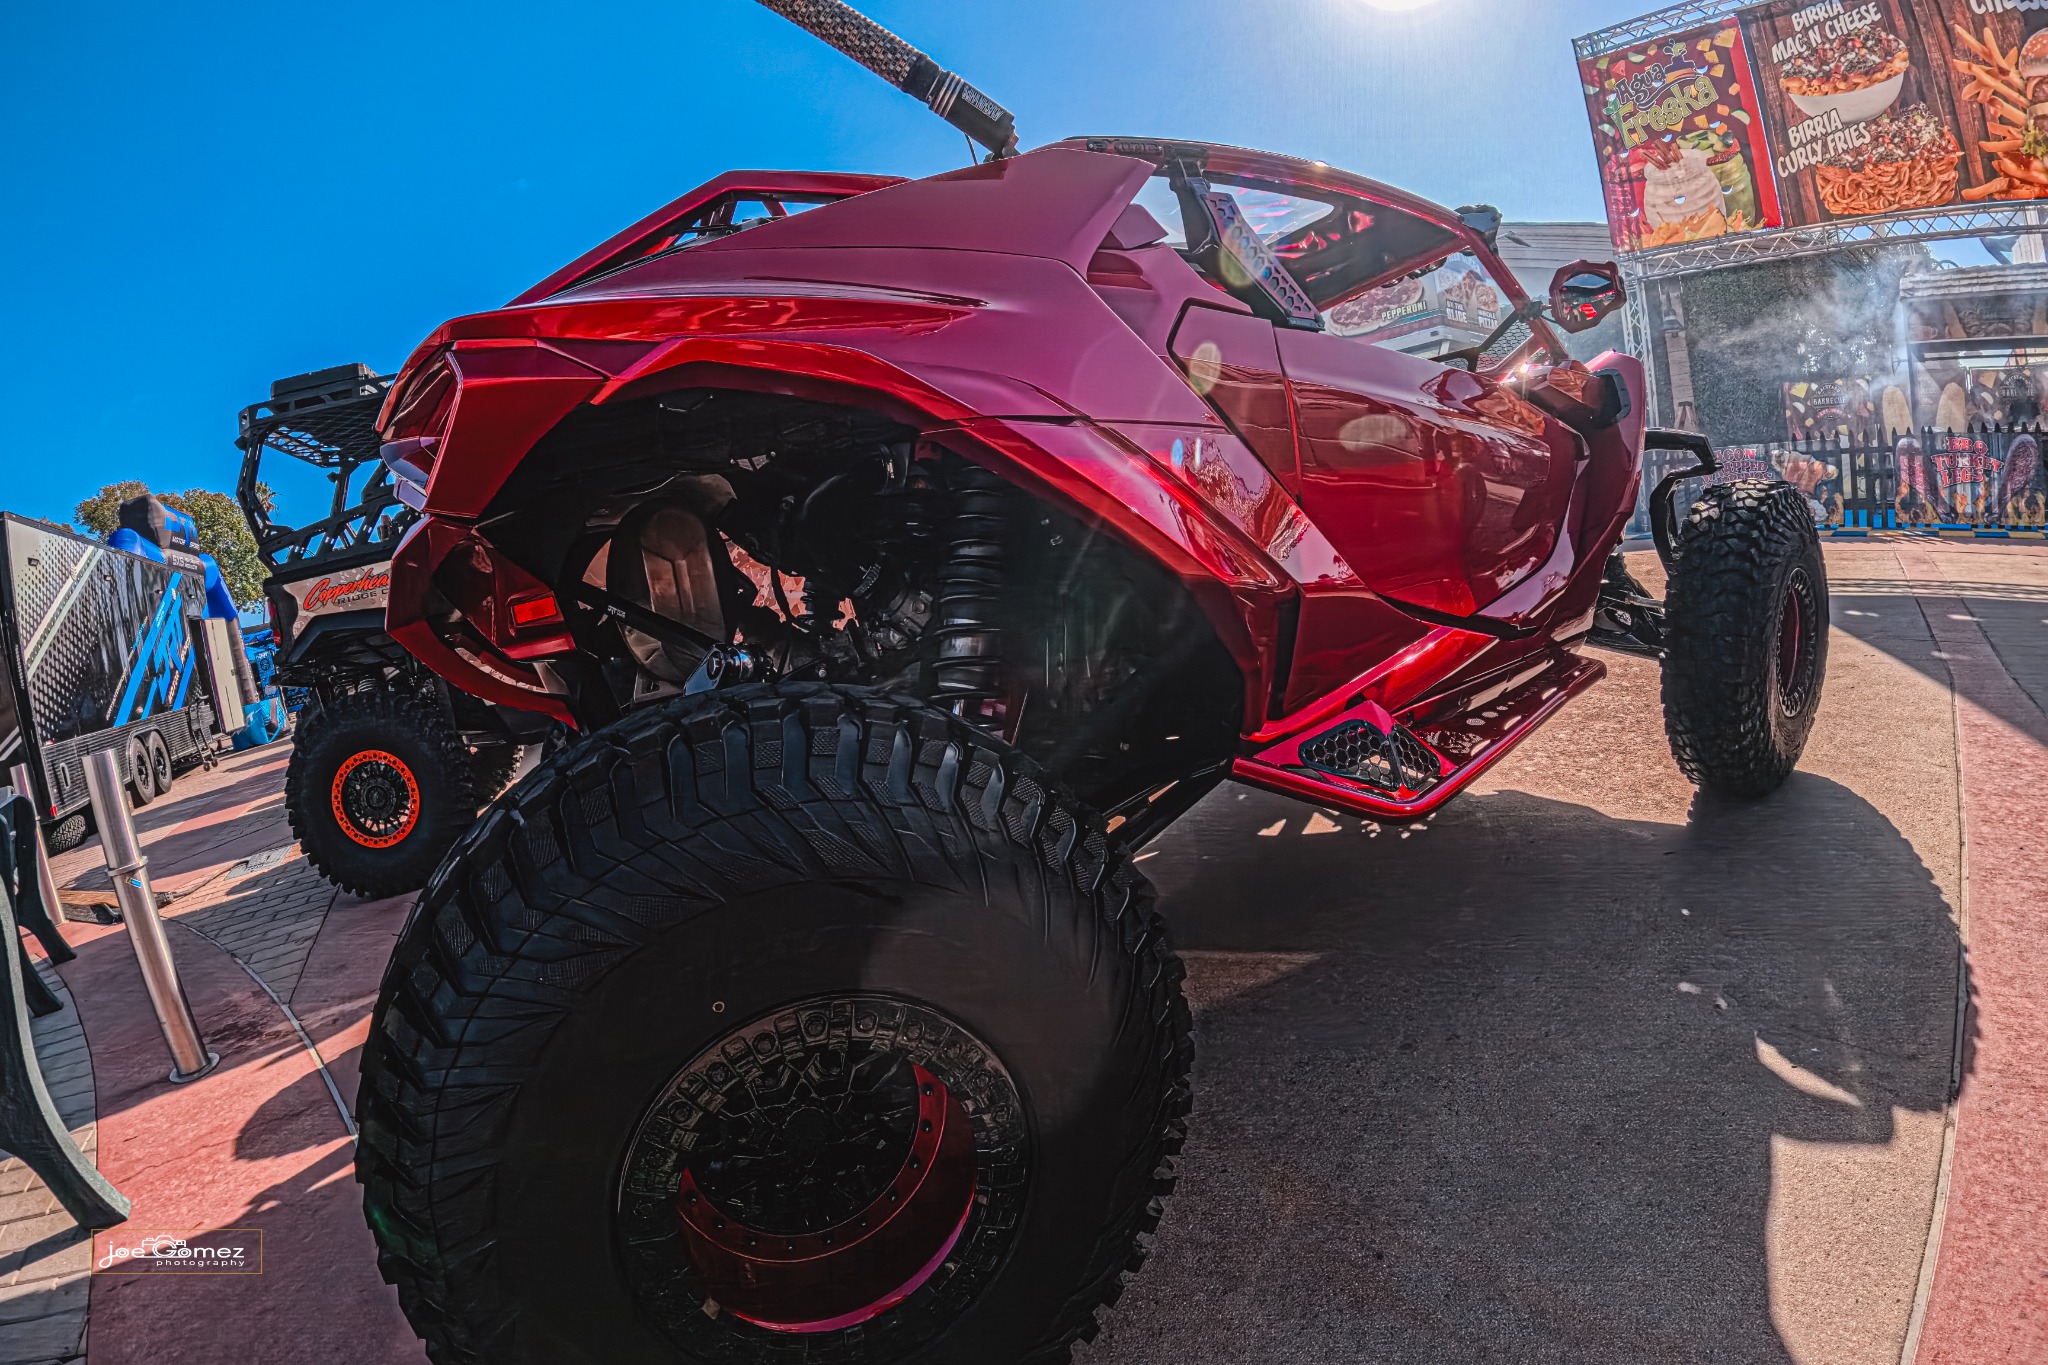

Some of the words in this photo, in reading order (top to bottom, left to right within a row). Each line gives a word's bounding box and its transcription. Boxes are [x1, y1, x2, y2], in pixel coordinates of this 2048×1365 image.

[1791, 0, 1845, 32] BIRRIA
[1772, 34, 1807, 64] MAC
[1808, 25, 1822, 47] N
[1825, 2, 1882, 39] CHEESE
[1615, 63, 1665, 108] Agua
[1611, 75, 1719, 149] Freska
[1788, 108, 1843, 148] BIRRIA
[1778, 139, 1823, 177] CURLY
[1827, 122, 1871, 158] FRIES
[1381, 301, 1426, 321] PEPPERONI
[1446, 308, 1467, 323] SLICE
[1813, 397, 1847, 406] BARBECUE
[1714, 448, 1757, 461] ACON
[1946, 437, 1988, 455] BBQ
[1931, 453, 2004, 473] TURKEY
[1941, 468, 1984, 488] LEGS
[303, 567, 390, 611] Copperhea
[337, 590, 377, 604] RIDGE
